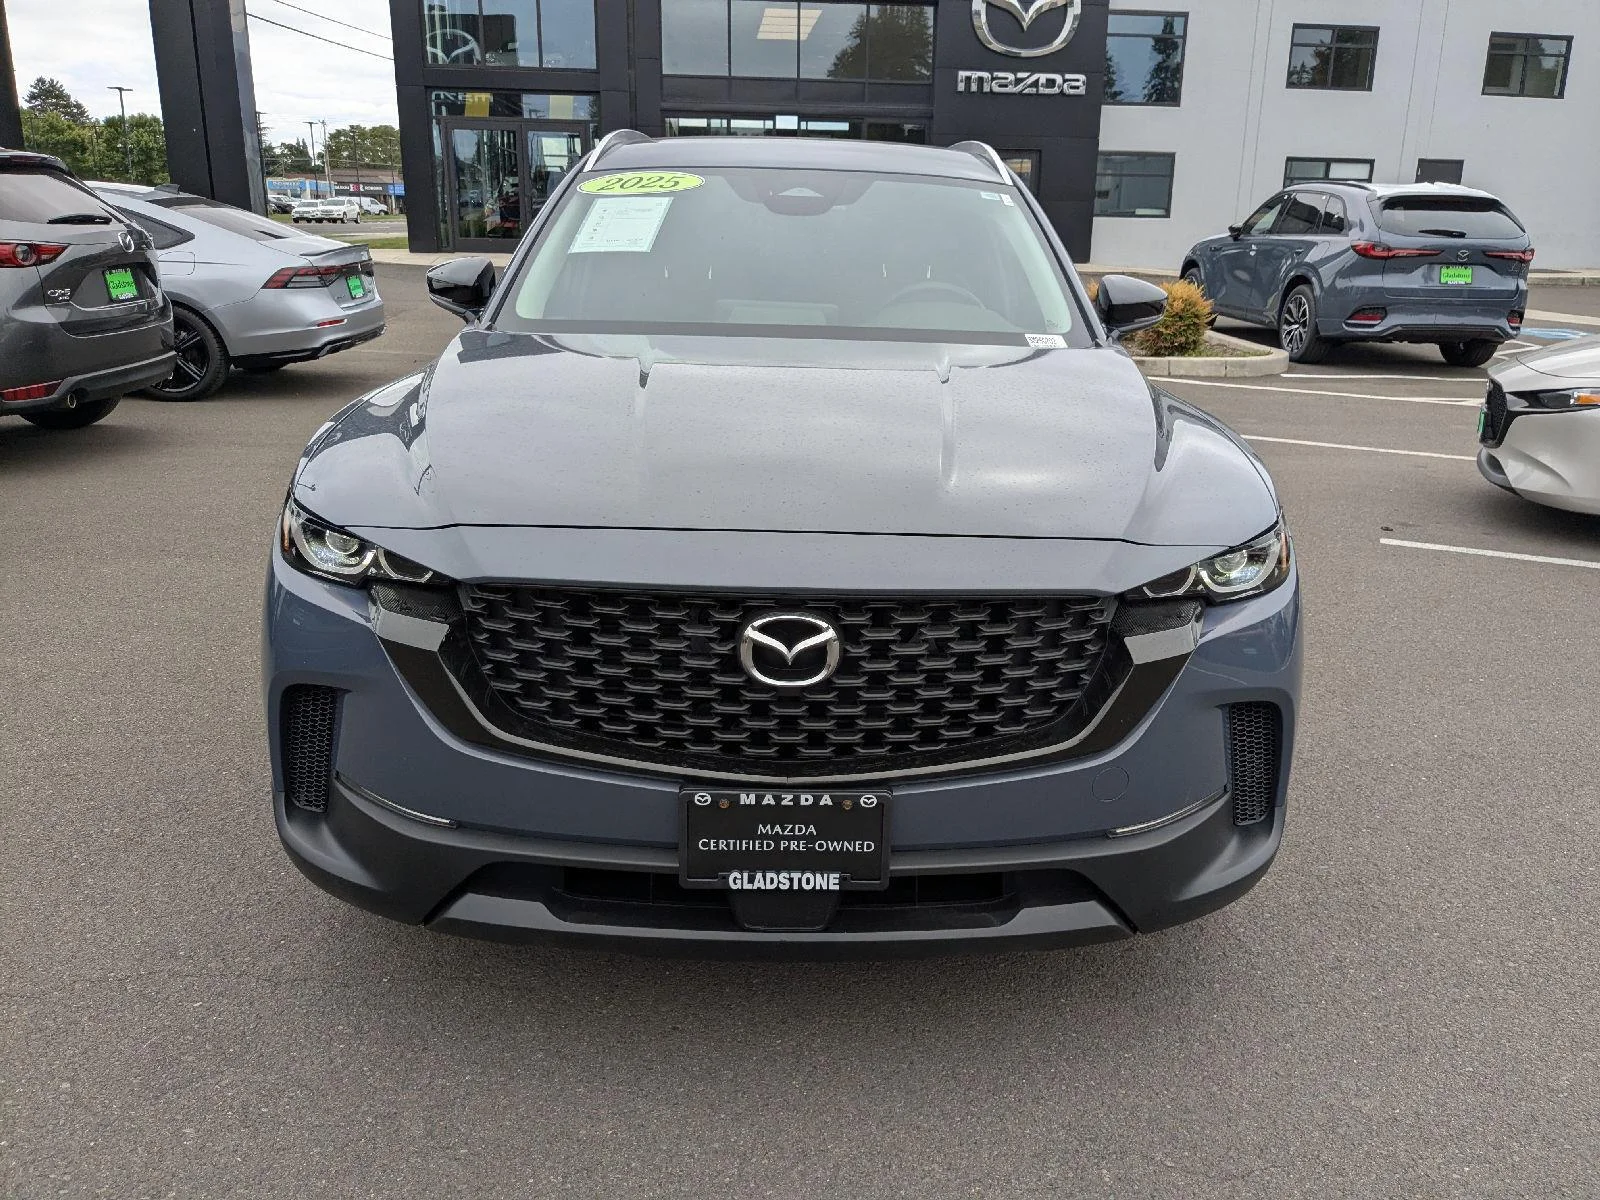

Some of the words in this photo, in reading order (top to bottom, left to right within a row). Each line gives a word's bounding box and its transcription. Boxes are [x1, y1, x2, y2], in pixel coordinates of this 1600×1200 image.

[595, 175, 685, 192] 2025
[47, 288, 71, 297] CX-5
[739, 793, 833, 806] MAZDA
[757, 824, 817, 836] MAZDA
[698, 838, 775, 851] CERTIFIED
[780, 840, 875, 852] PRE-OWNED
[728, 871, 840, 890] GLADSTONE
